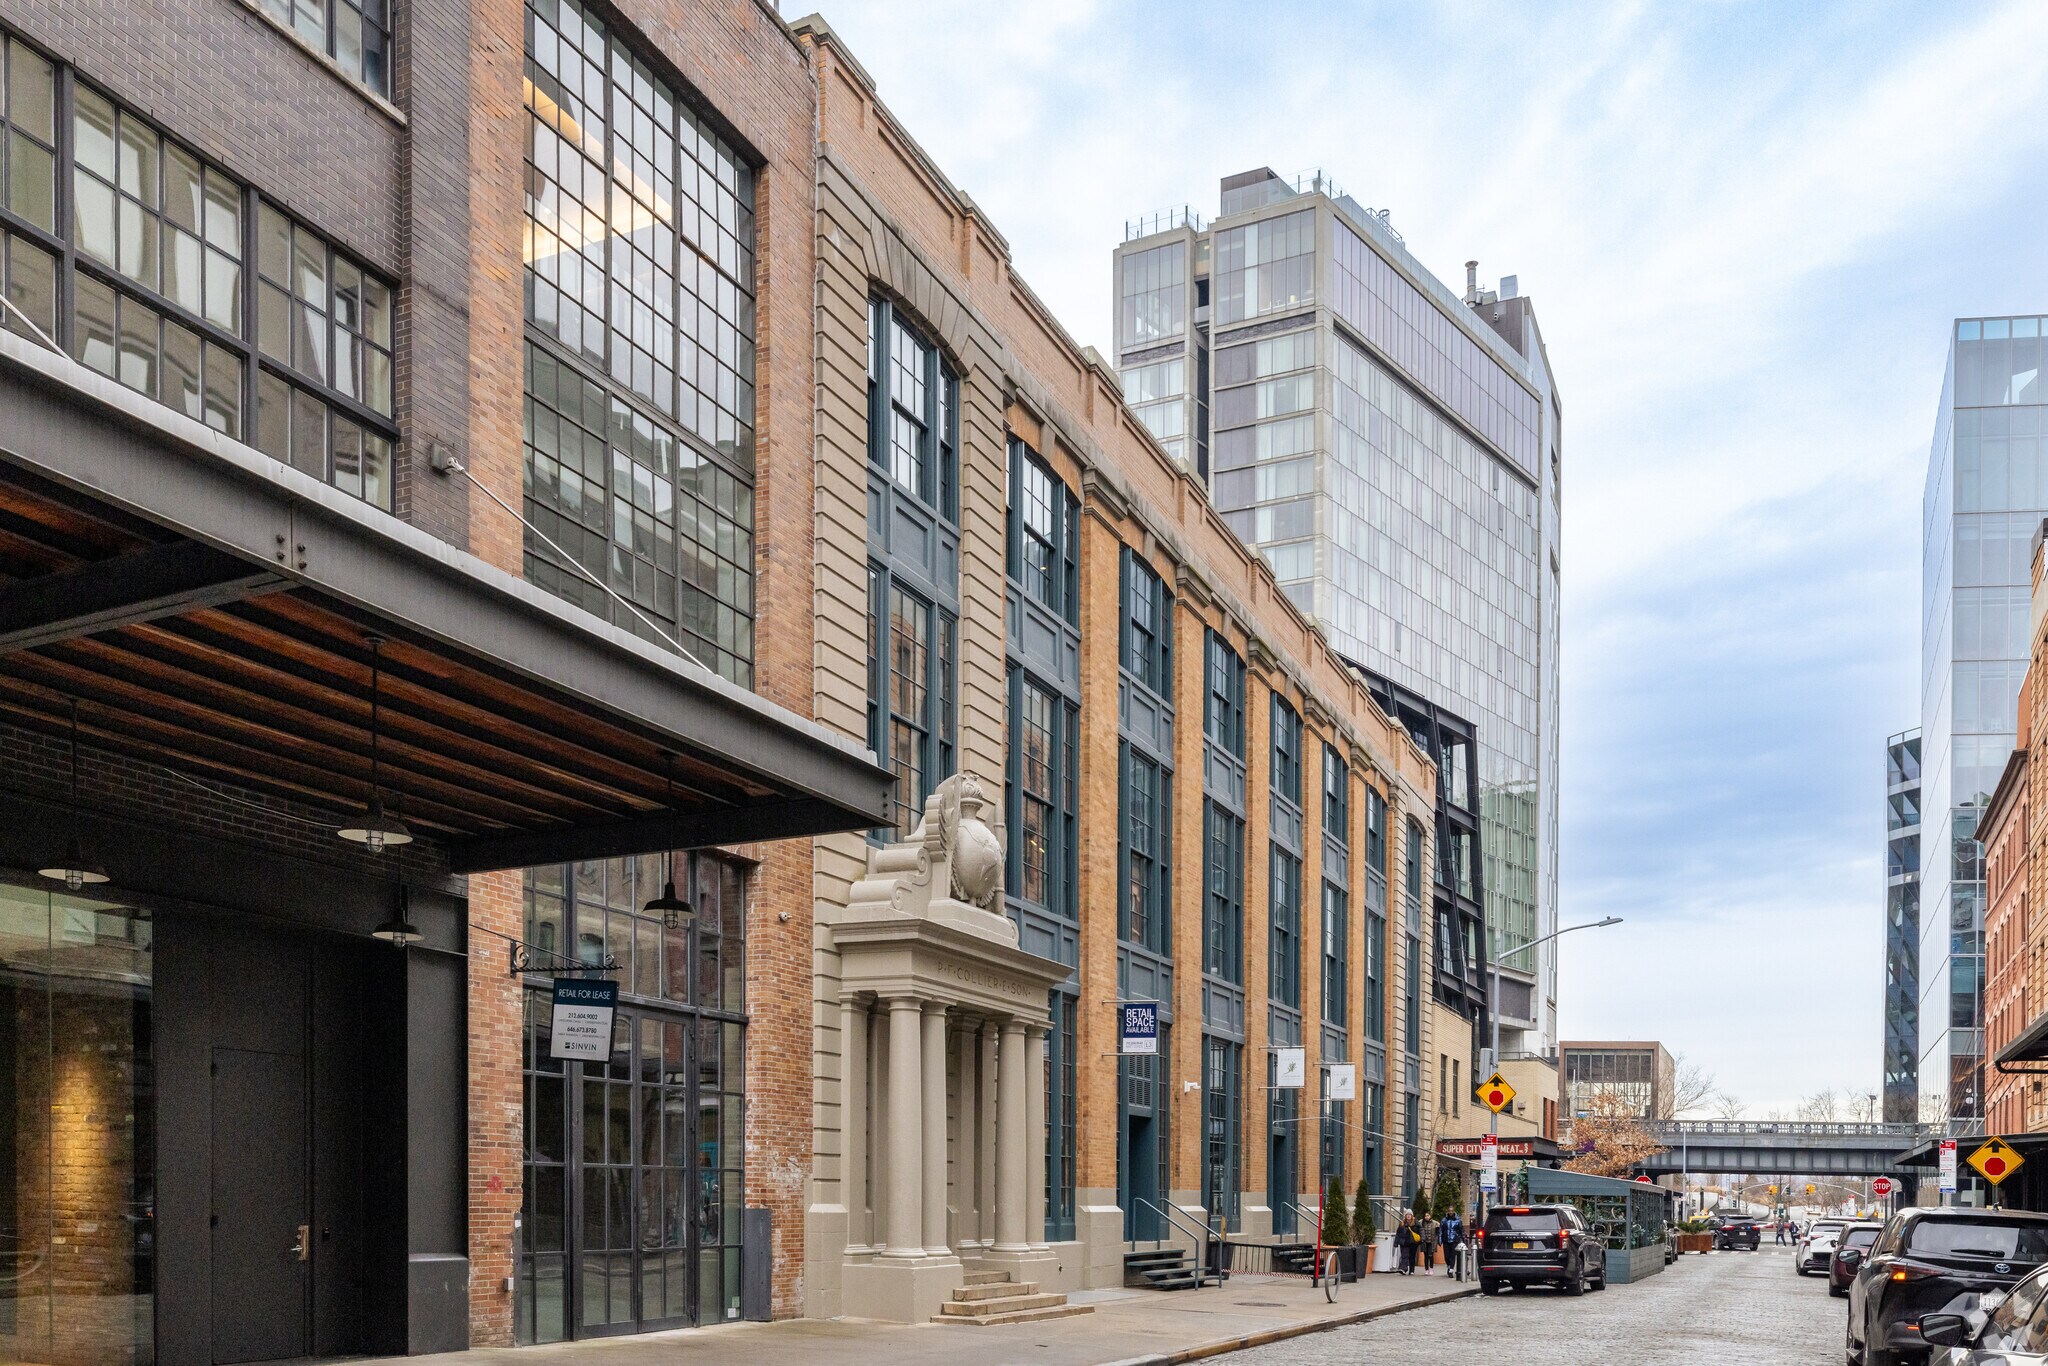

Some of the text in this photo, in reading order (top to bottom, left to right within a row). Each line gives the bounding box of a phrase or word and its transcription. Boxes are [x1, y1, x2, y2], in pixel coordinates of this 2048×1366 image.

[558, 988, 611, 1000] RETAIL FOR LEASE
[1126, 1008, 1154, 1018] RETAIL
[1126, 1017, 1154, 1027] SPACE
[571, 1042, 597, 1051] SINVIN
[1442, 1144, 1464, 1153] SUPER
[1500, 1144, 1519, 1153] MEAT
[1873, 1182, 1890, 1190] STOP
